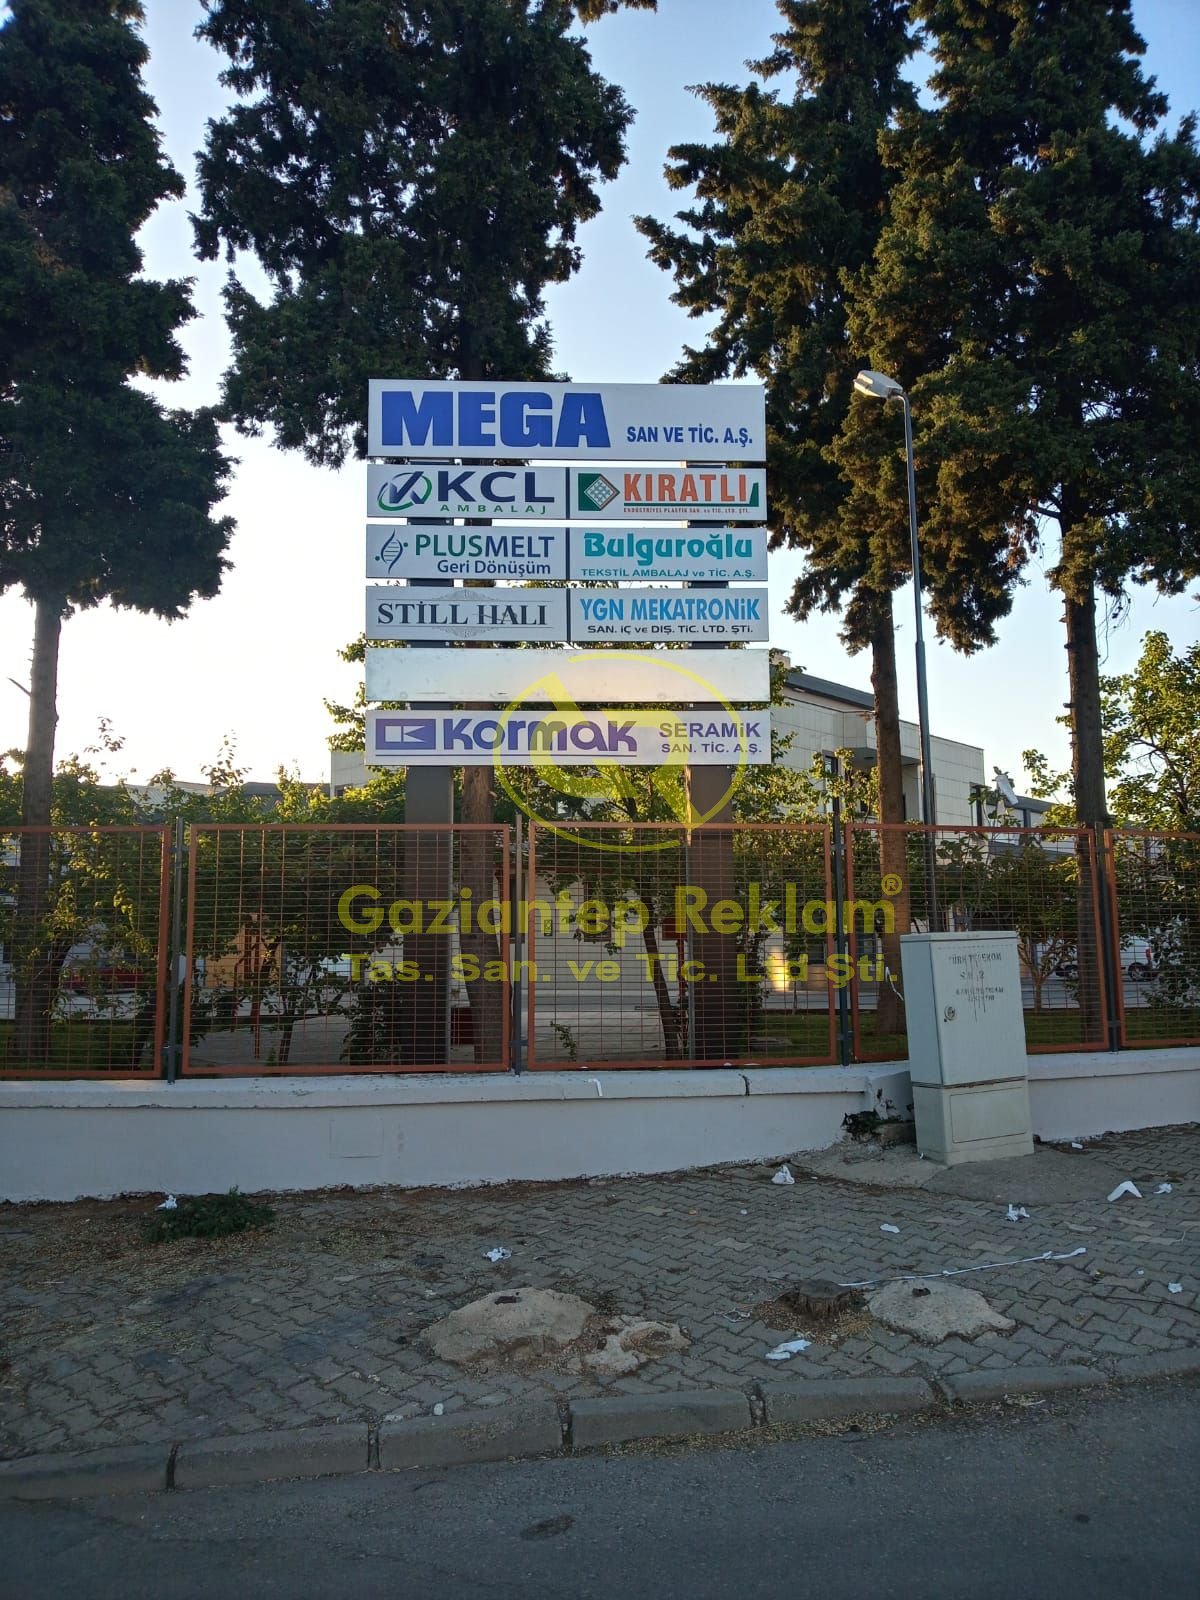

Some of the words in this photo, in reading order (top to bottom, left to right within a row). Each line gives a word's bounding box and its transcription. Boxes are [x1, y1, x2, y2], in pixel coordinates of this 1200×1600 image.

[381, 391, 611, 448] MEGA
[626, 426, 658, 443] SAN
[663, 427, 684, 443] VE
[688, 423, 719, 444] TİC.
[723, 427, 753, 447] A.Ş.
[437, 471, 555, 503] KCL
[623, 473, 747, 502] KIRATLI
[440, 504, 546, 515] AMBALAJ
[415, 534, 555, 558] PLUSMELT
[584, 532, 753, 567] Bulguroğlu
[437, 559, 470, 574] Geri
[474, 560, 551, 578] Dönüşüm
[581, 567, 630, 578] TEKSTİL
[632, 569, 690, 578] AMBALAJ
[733, 569, 757, 580] A.Ş.
[377, 600, 469, 625] STİLL
[477, 604, 548, 626] HALI
[580, 598, 625, 621] YGN
[587, 625, 617, 634] SAN.
[702, 625, 729, 634] LTD.
[661, 743, 697, 753] SAN.
[733, 743, 763, 755] A.Ş.
